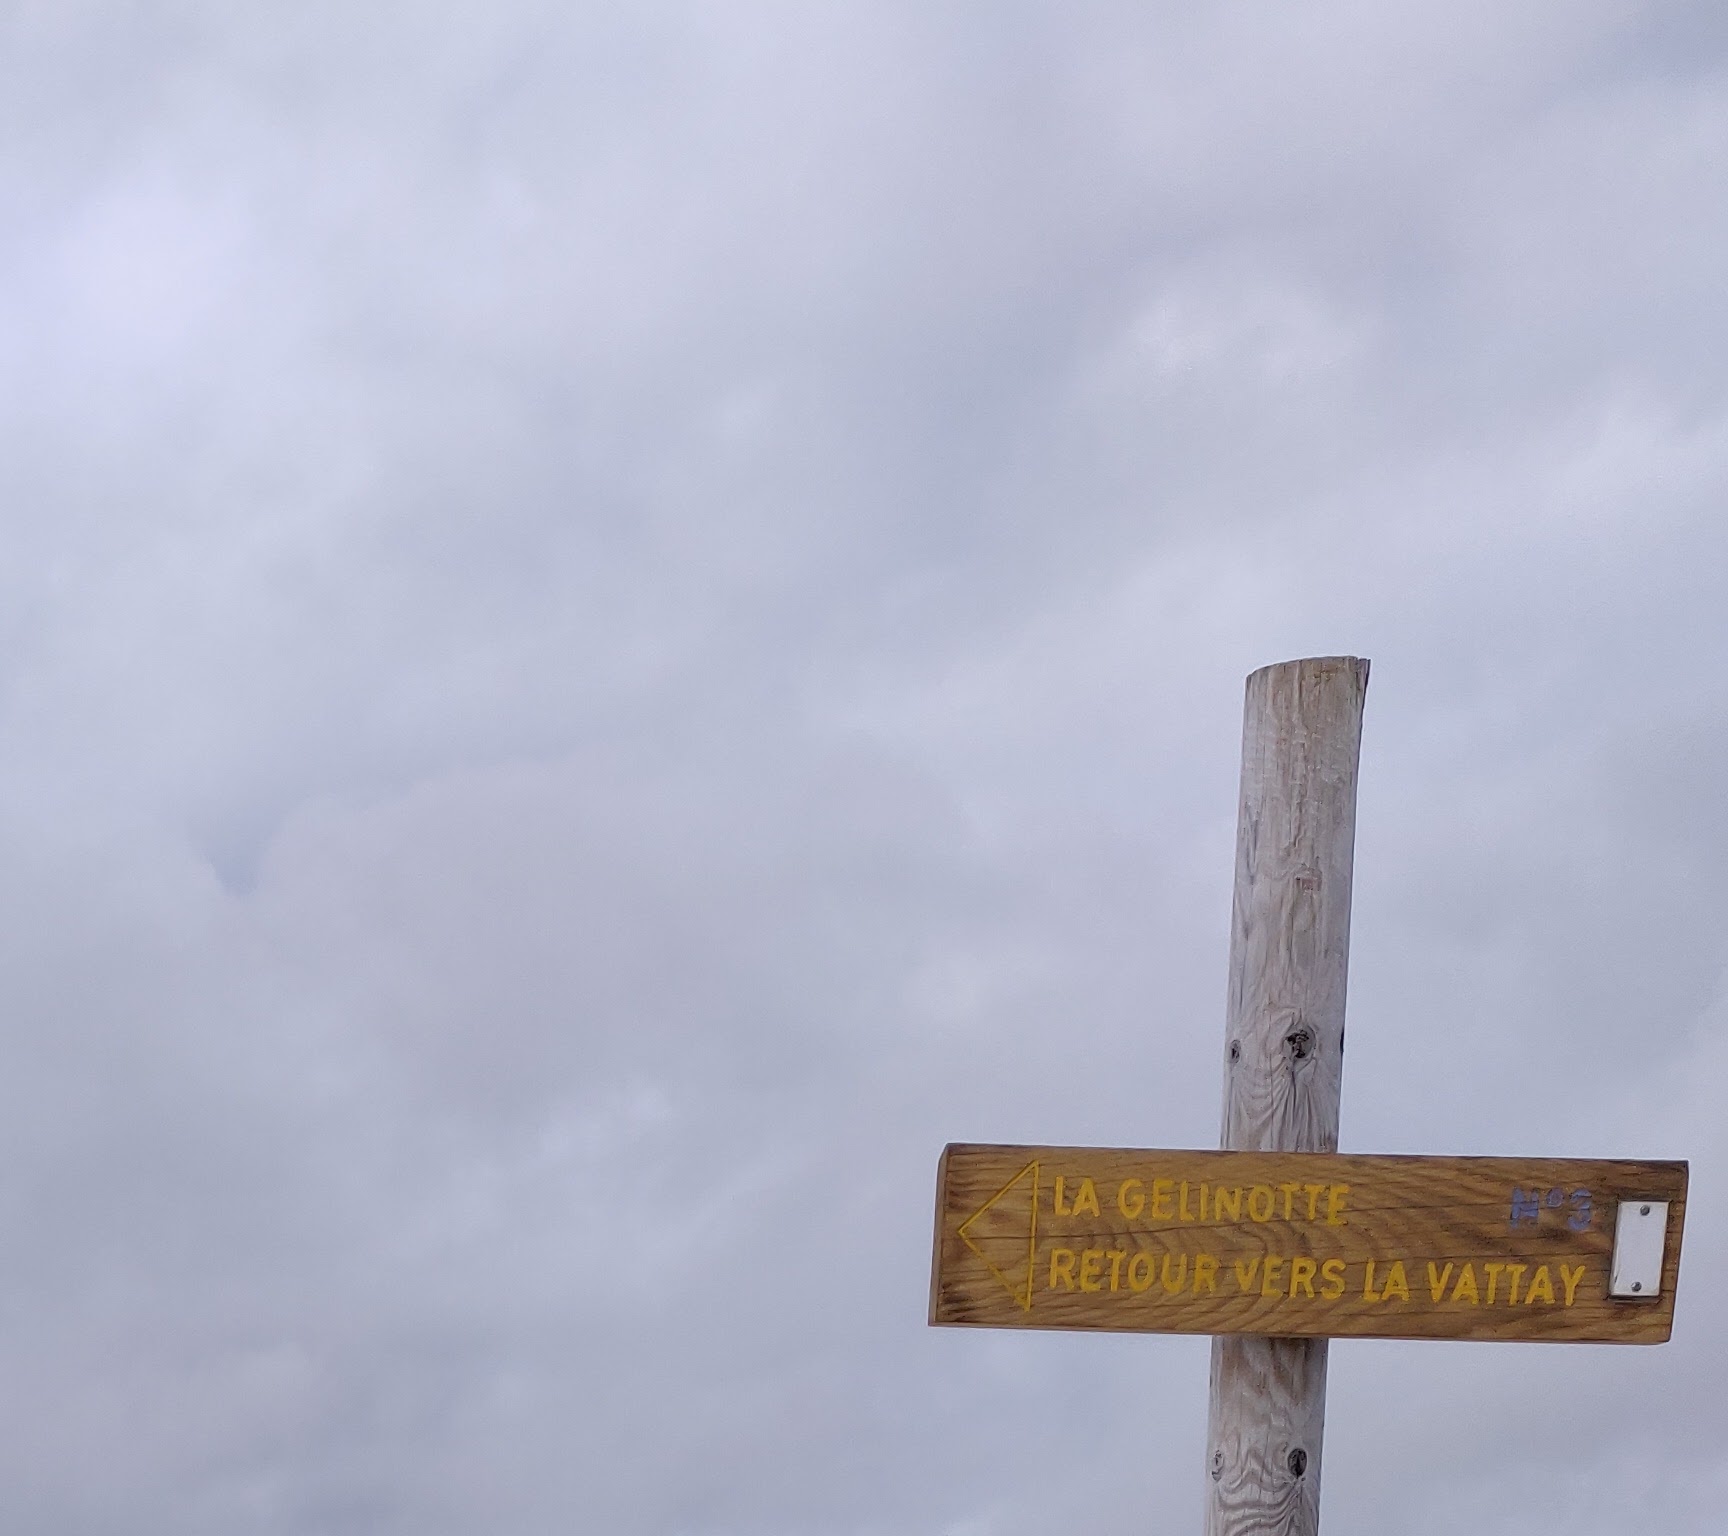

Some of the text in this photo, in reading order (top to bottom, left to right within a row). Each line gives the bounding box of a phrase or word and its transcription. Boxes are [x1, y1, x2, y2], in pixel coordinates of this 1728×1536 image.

[1054, 1176, 1350, 1226] LA GELINOTTE
[1049, 1248, 1586, 1307] RETOUR VERS LA VATTAY
